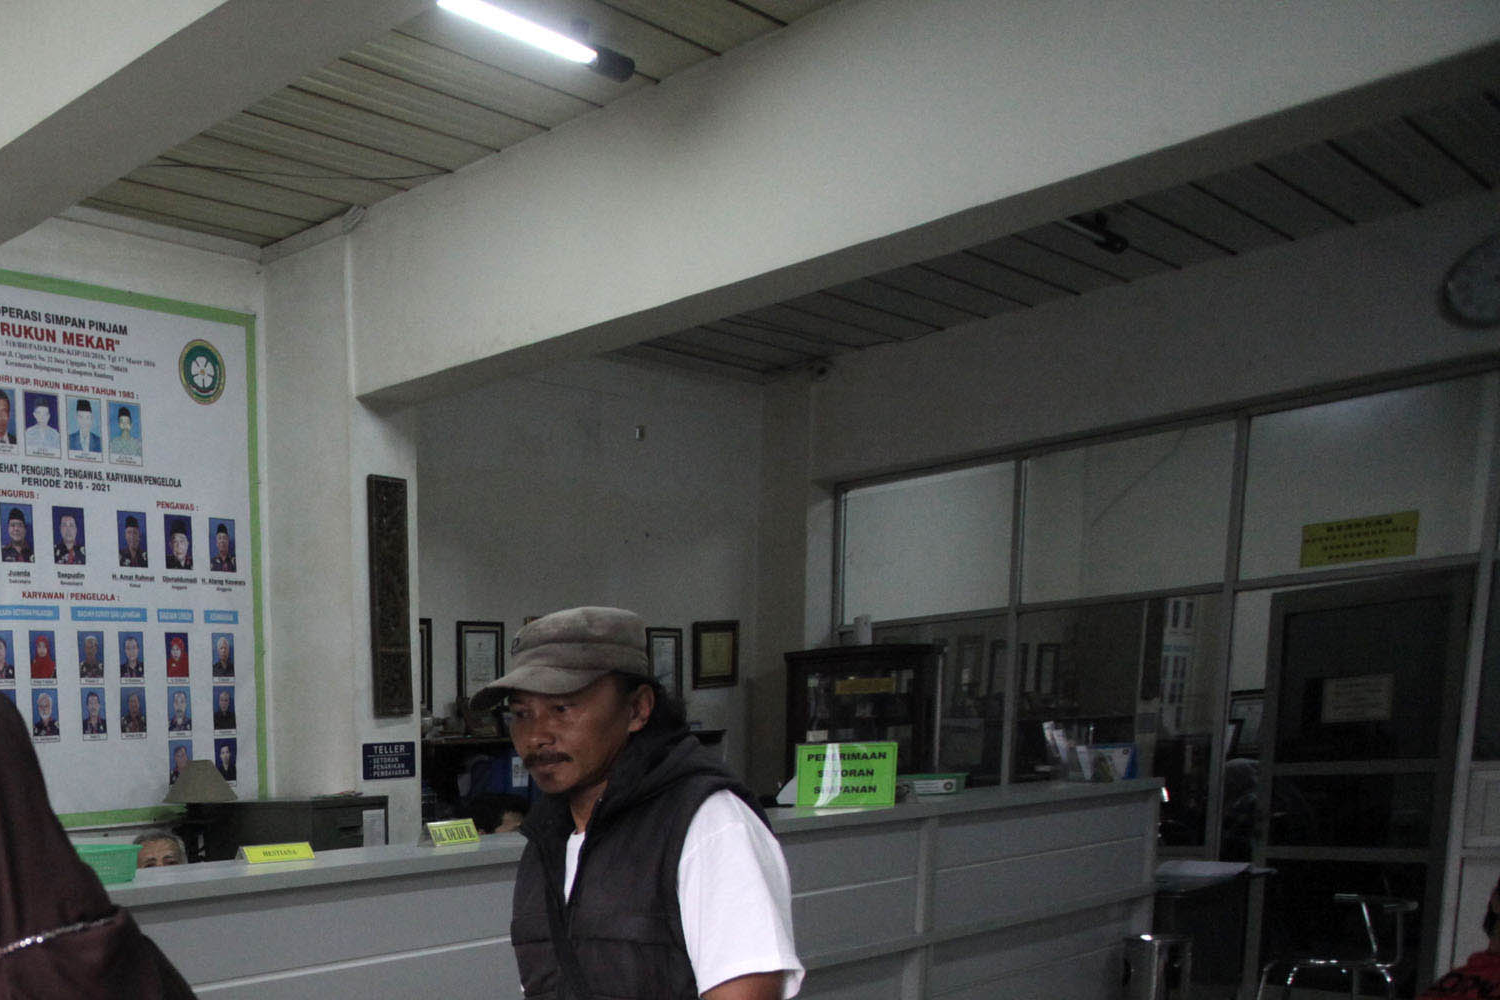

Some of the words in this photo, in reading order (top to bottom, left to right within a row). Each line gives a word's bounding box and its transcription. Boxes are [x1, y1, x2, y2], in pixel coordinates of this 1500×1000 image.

[44, 313, 86, 329] SIMPAN
[88, 321, 128, 336] PINJAM
[62, 330, 120, 352] MEKAR"
[33, 379, 60, 390] RUKUN
[62, 382, 90, 393] MEKAR
[91, 386, 117, 397] TAHUN
[21, 476, 61, 489] PERIODE
[156, 500, 195, 512] PENGAWAS
[22, 591, 65, 600] KARYAWAN
[70, 592, 116, 601] PENGELOLA
[373, 745, 406, 754] TELLER
[817, 768, 875, 778] SORAN
[814, 785, 877, 795] SANAN
